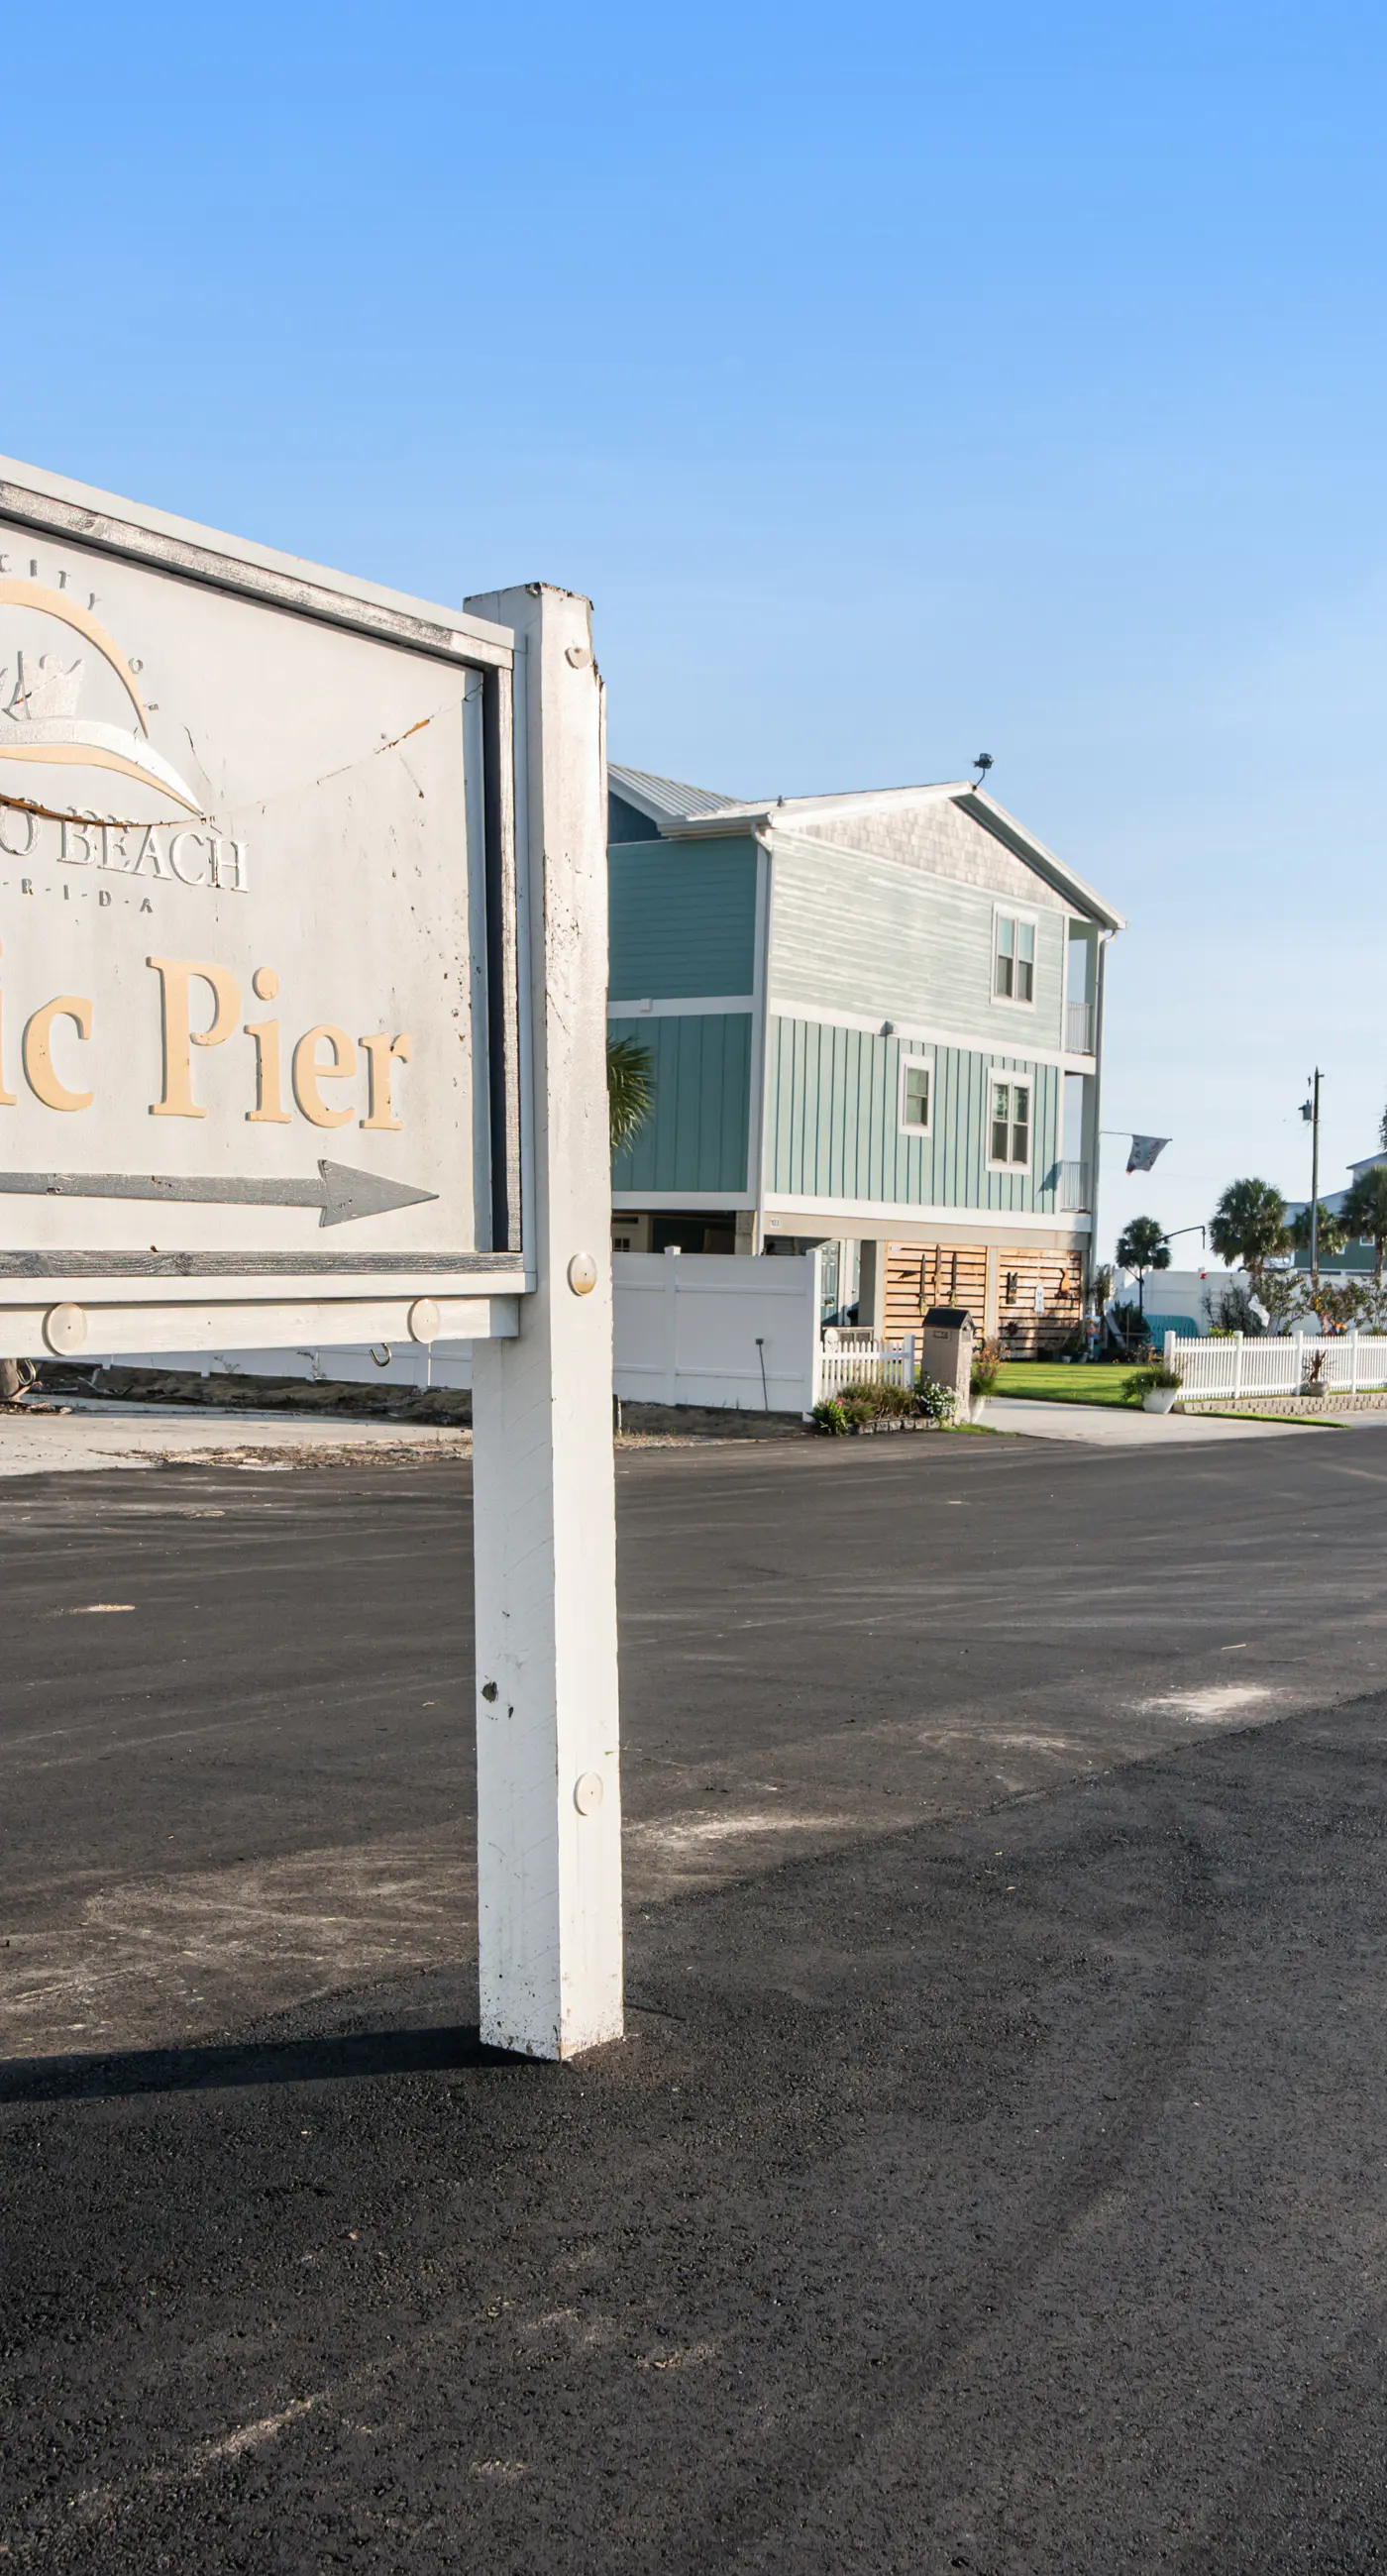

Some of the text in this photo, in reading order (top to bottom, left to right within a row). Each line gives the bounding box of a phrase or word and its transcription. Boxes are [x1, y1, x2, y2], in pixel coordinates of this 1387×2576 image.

[56, 805, 250, 893] BEACH
[0, 941, 413, 1131] c Pier
